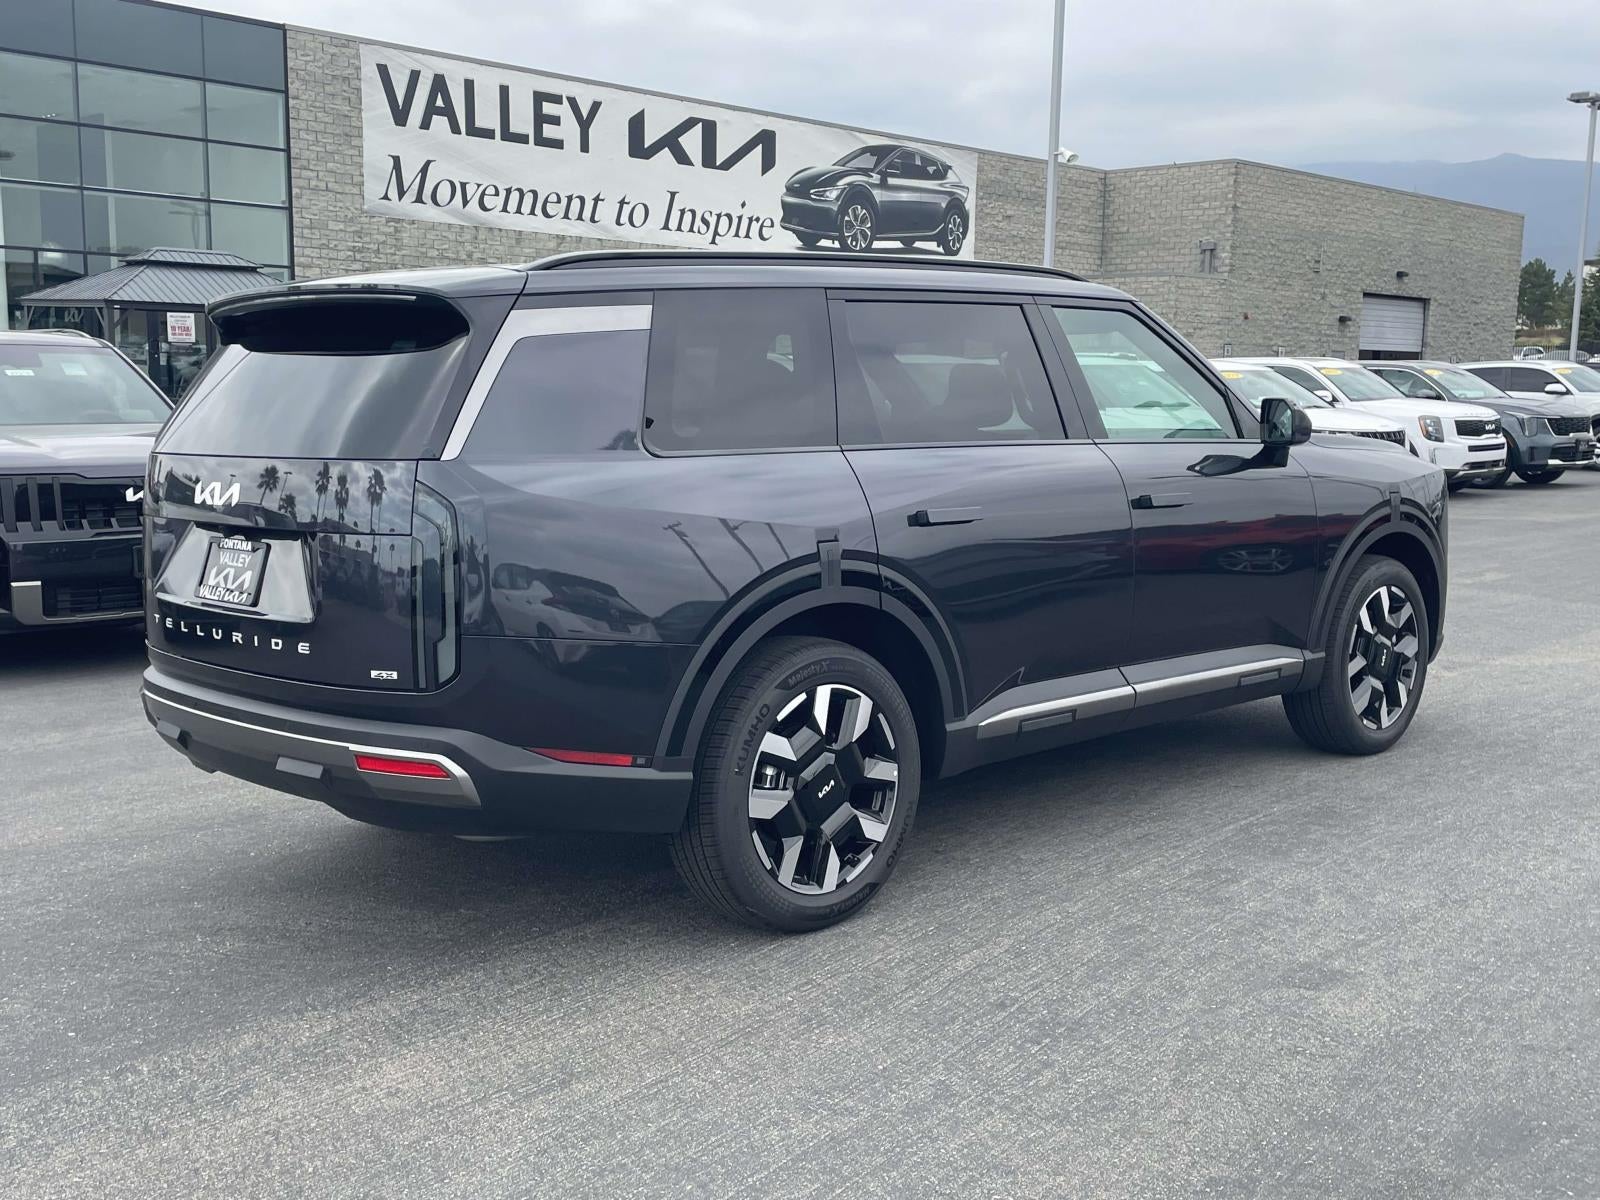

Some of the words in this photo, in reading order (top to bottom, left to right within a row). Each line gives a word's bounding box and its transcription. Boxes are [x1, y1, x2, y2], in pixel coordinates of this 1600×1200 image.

[376, 63, 602, 153] VALLEY
[628, 109, 777, 176] KIA
[378, 154, 605, 225] Movement
[614, 196, 650, 229] to
[659, 190, 775, 245] Inspire
[194, 480, 241, 507] KIA
[219, 537, 252, 551] FONTANA
[219, 551, 251, 568] VALLEY
[208, 566, 253, 591] KIA
[199, 584, 227, 601] VALLEY
[153, 613, 311, 655] TELLURIDE
[734, 703, 771, 777] KUMHO
